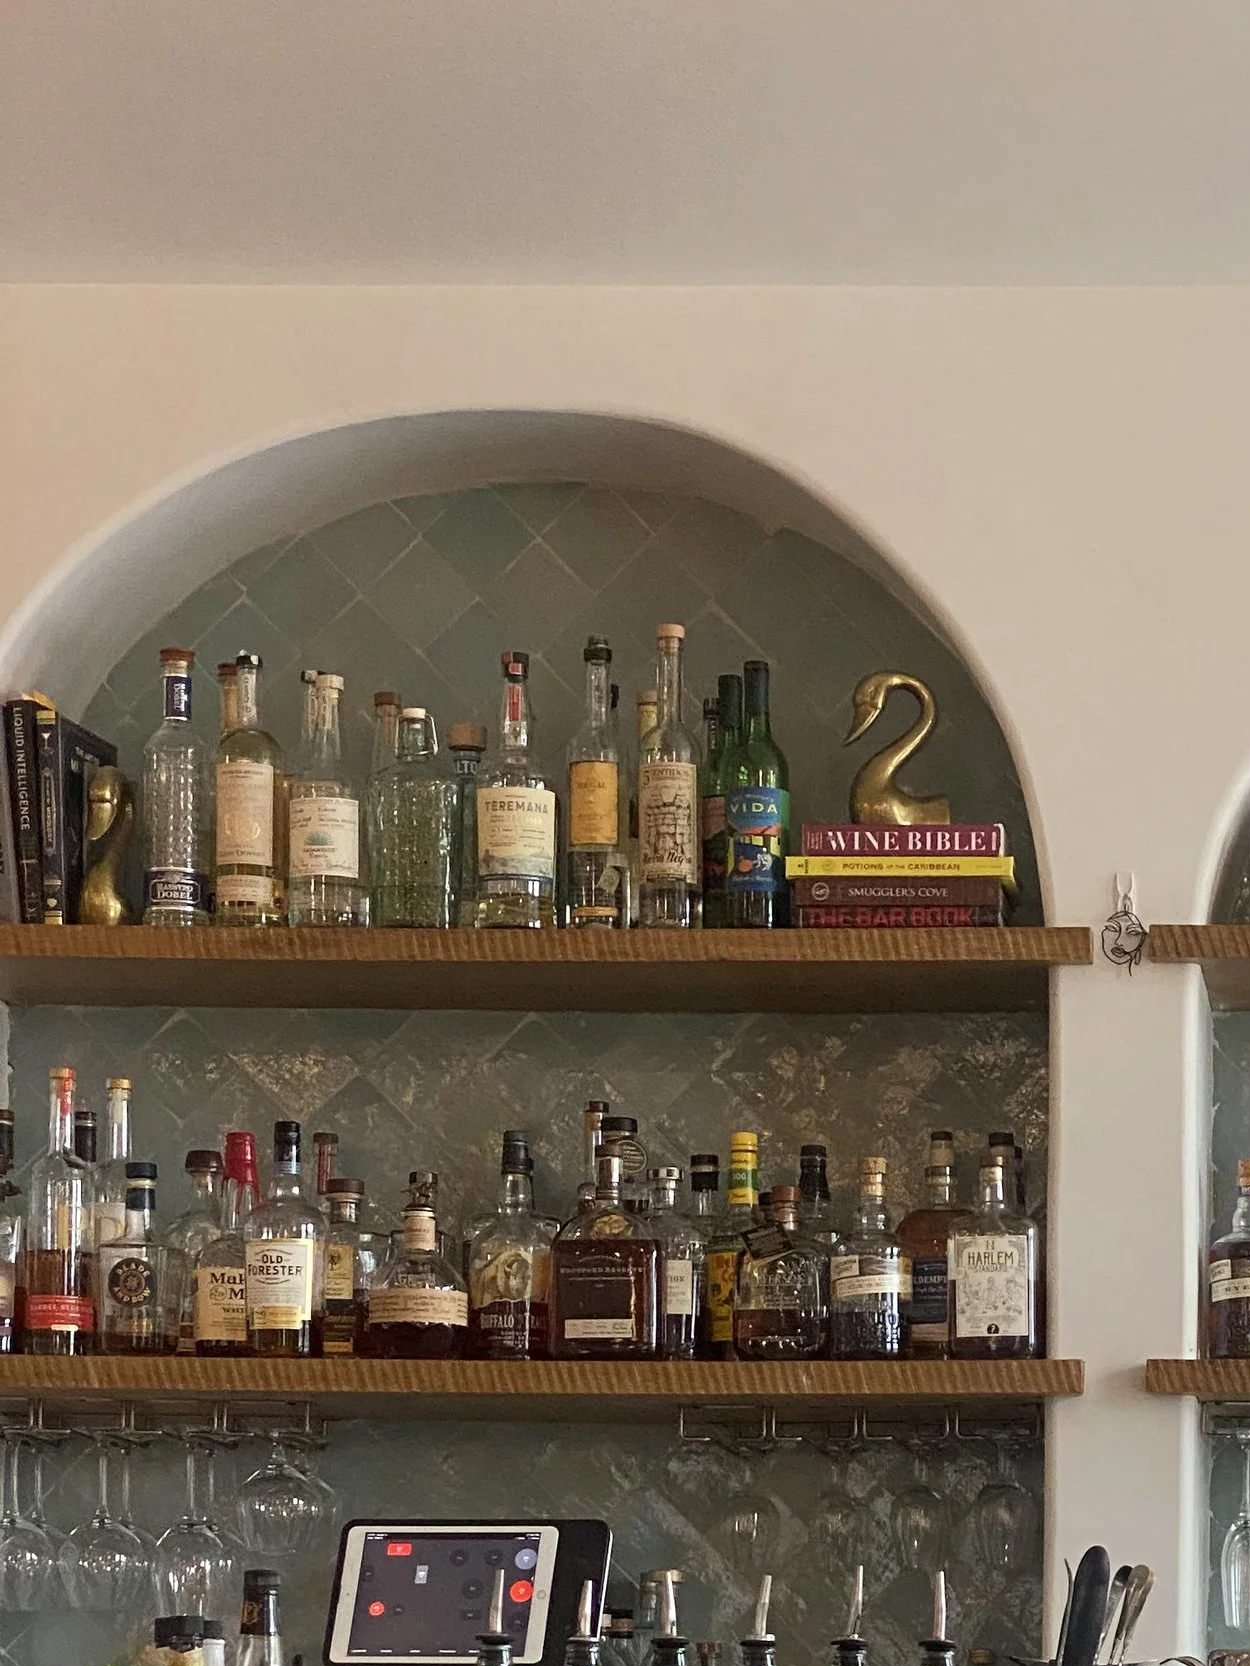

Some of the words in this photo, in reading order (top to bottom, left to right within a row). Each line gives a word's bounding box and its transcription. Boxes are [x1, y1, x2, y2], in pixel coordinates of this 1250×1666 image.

[13, 707, 25, 746] LIQUID
[15, 747, 31, 831] INTELLIGENCE
[484, 800, 548, 814] TEREMANA
[730, 802, 778, 814] VIDA
[827, 831, 899, 851] WINE
[907, 831, 987, 851] BIBLE
[842, 863, 884, 871] POTIONS
[907, 863, 961, 871] CARIBBEAN
[157, 888, 193, 900] DOBEL
[848, 887, 916, 898] SMUGGLER'S
[918, 887, 949, 898] COVE
[807, 906, 852, 927] THE
[855, 906, 905, 927] BAR
[909, 906, 972, 926] BOOK
[732, 1172, 747, 1181] 100
[261, 1253, 283, 1264] OLD
[967, 1251, 1014, 1266] HARLEM
[116, 1262, 150, 1277] BLADE
[247, 1264, 303, 1277] FORESTER
[973, 1264, 1009, 1273] STANDARD
[131, 1287, 152, 1304] BOW
[480, 1313, 514, 1329] BUFFALO
